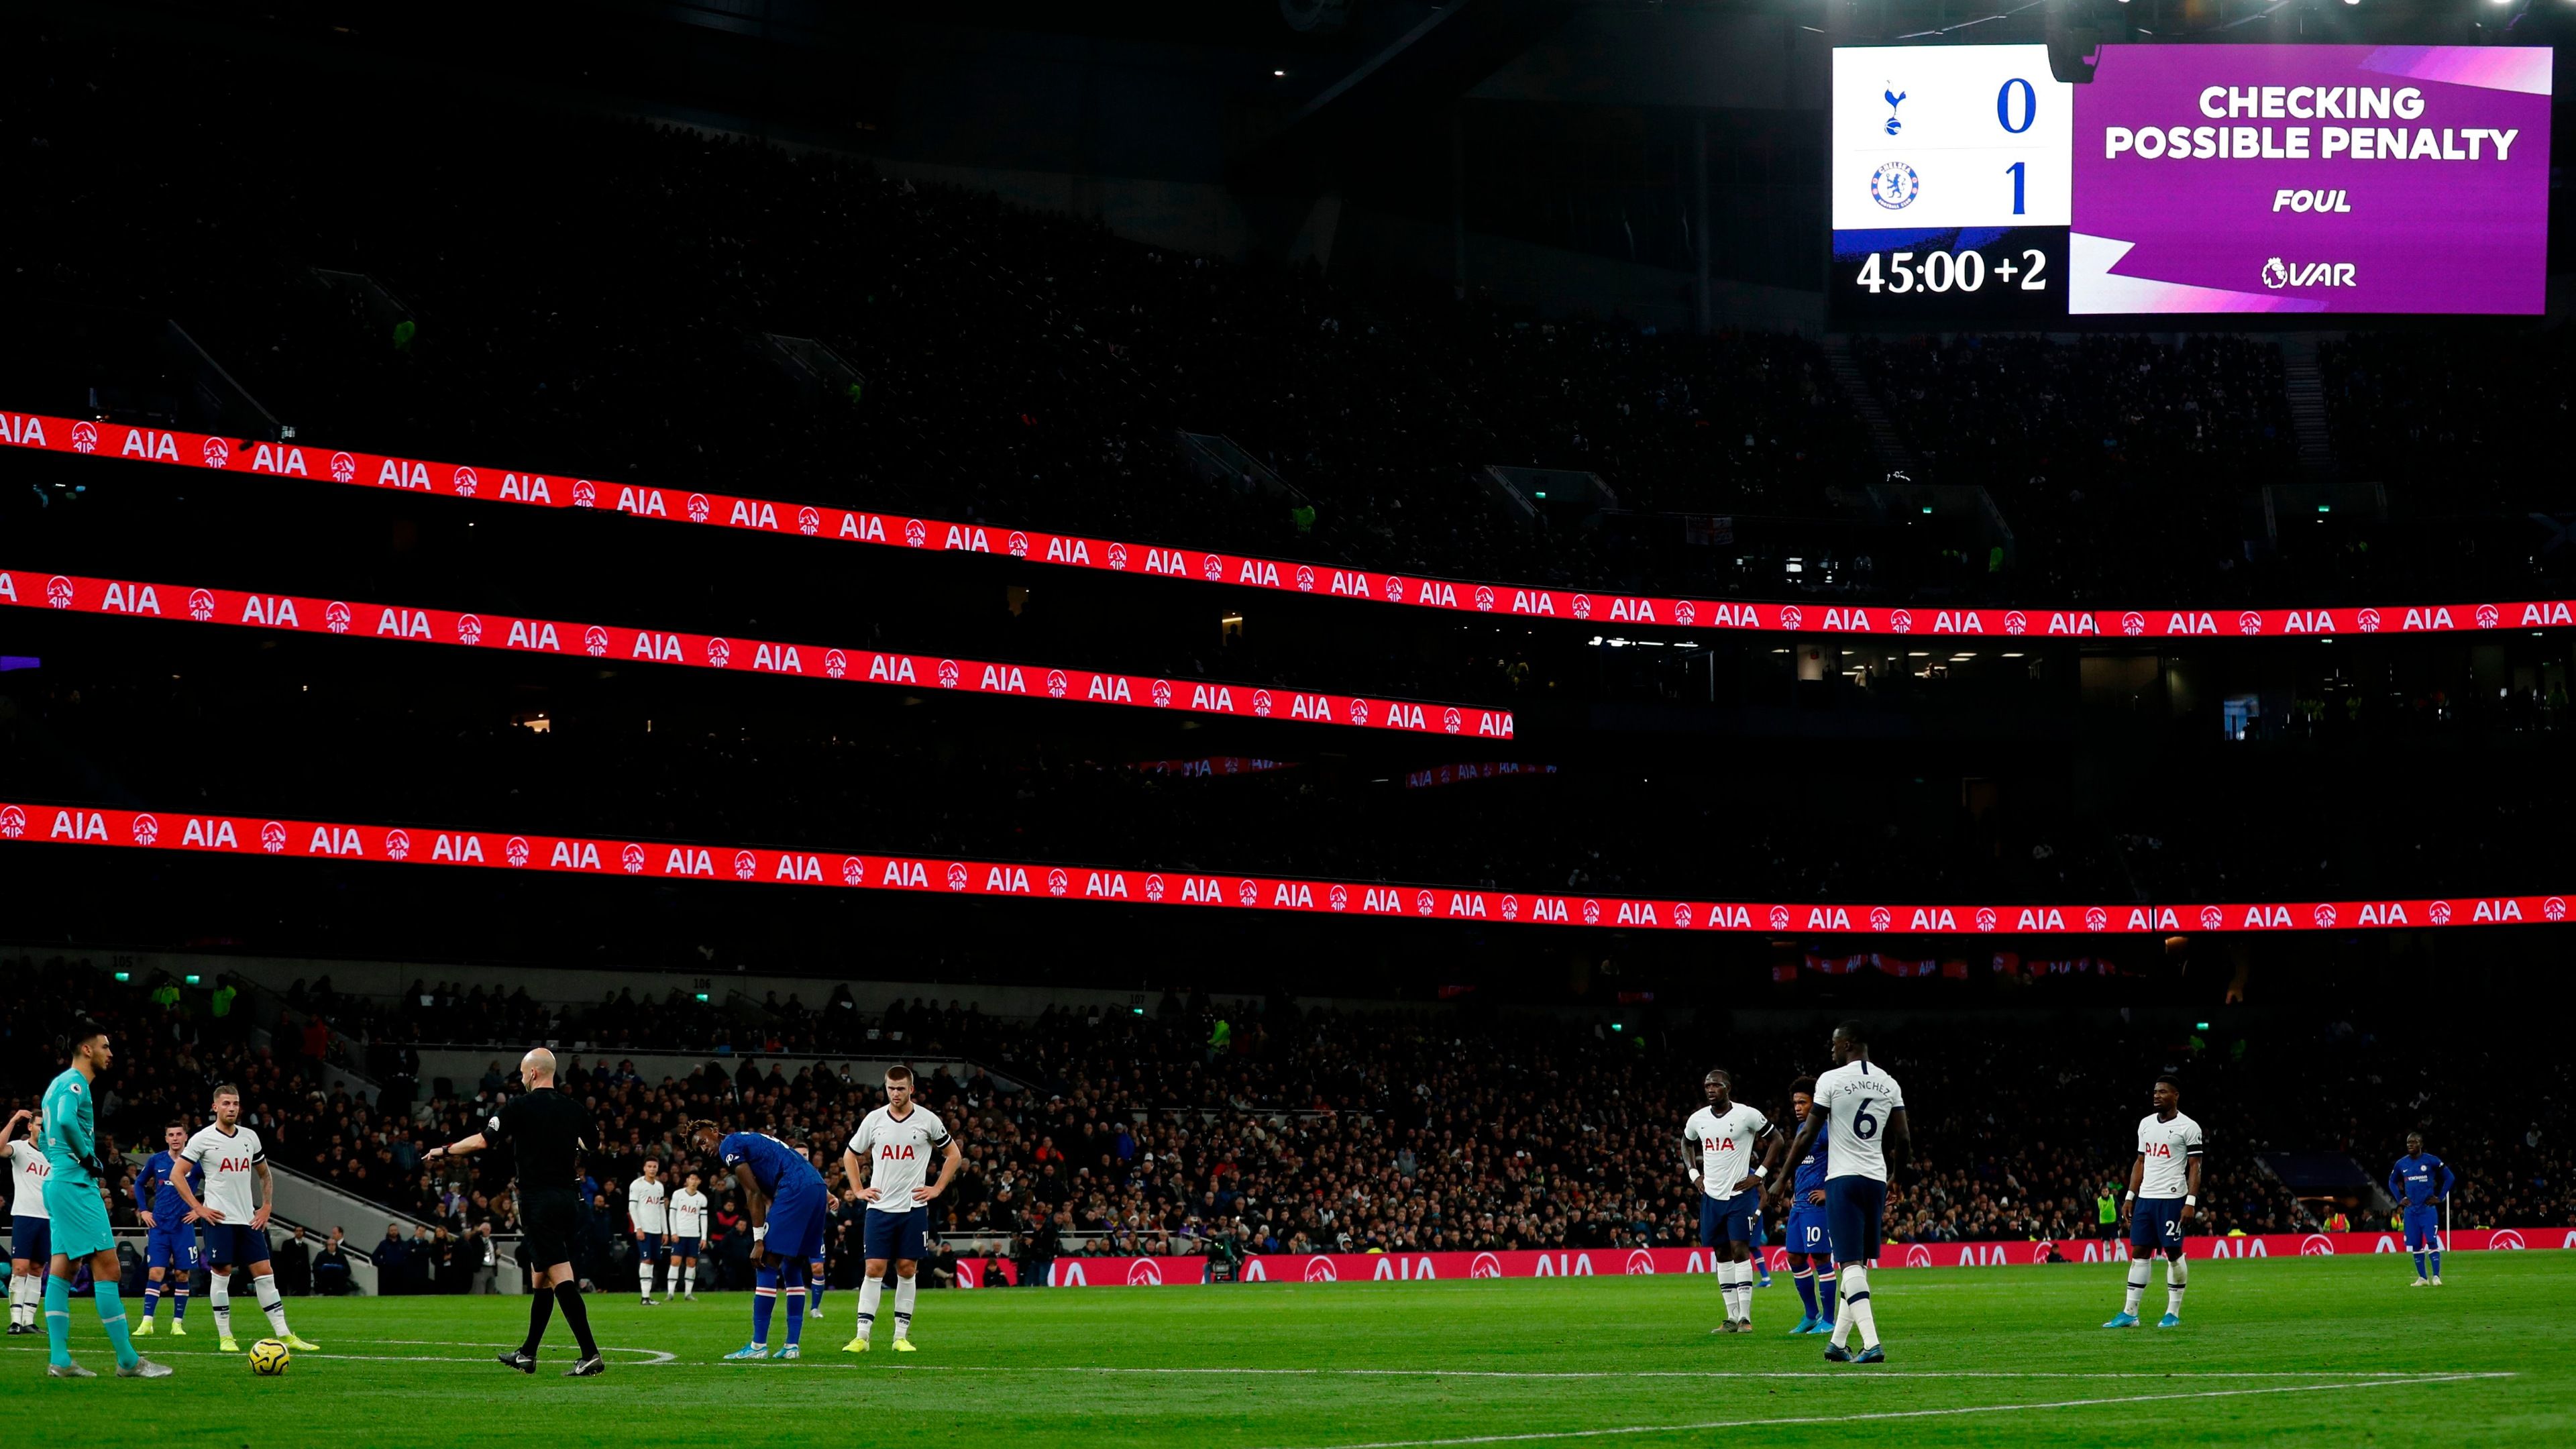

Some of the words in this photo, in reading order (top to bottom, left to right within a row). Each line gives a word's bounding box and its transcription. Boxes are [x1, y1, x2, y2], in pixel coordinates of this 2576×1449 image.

[1996, 78, 2037, 133] 0
[2198, 85, 2426, 119] CHECKING
[2105, 125, 2311, 160] POSSIBLE
[2321, 126, 2519, 161] PENALTY
[2005, 162, 2026, 215] 1
[2271, 189, 2352, 213] FOUL
[1856, 250, 1986, 294] 45:00
[1993, 248, 2047, 291] +2
[2289, 262, 2357, 287] VAR
[122, 429, 179, 461] AIA
[252, 444, 307, 476] AIA
[378, 460, 431, 490] AIA
[499, 474, 551, 504] AIA
[616, 487, 667, 517] AIA
[730, 500, 778, 529] AIA
[839, 513, 886, 541] AIA
[945, 525, 989, 553] AIA
[1046, 537, 1090, 565] AIA
[1144, 549, 1187, 576] AIA
[1239, 560, 1280, 587] AIA
[1331, 571, 1370, 597] AIA
[1419, 582, 1457, 607] AIA
[1512, 590, 1555, 615] AIA
[1609, 598, 1656, 622] AIA
[1715, 604, 1760, 627] AIA
[1823, 608, 1870, 631] AIA
[1933, 611, 1984, 633] AIA
[2048, 612, 2100, 634] AIA
[2167, 612, 2218, 634] AIA
[2284, 610, 2336, 633] AIA
[2403, 607, 2454, 630] AIA
[2521, 602, 2573, 625] AIA
[101, 582, 160, 614] AIA
[241, 595, 299, 627] AIA
[377, 608, 432, 639] AIA
[507, 621, 560, 651] AIA
[633, 632, 684, 661] AIA
[753, 643, 802, 673] AIA
[869, 655, 916, 683] AIA
[981, 665, 1026, 693] AIA
[1088, 675, 1132, 702] AIA
[1191, 685, 1234, 712] AIA
[1291, 694, 1332, 720] AIA
[1387, 704, 1426, 729] AIA
[1479, 712, 1513, 737] AIA
[50, 810, 108, 841] AIA
[182, 818, 237, 848] AIA
[309, 826, 363, 855] AIA
[432, 834, 484, 862] AIA
[551, 841, 601, 869] AIA
[665, 848, 714, 875] AIA
[775, 855, 823, 881] AIA
[883, 861, 928, 888] AIA
[986, 867, 1030, 892] AIA
[1085, 872, 1128, 898] AIA
[1181, 878, 1222, 903] AIA
[1274, 883, 1313, 908] AIA
[1363, 888, 1401, 912] AIA
[1450, 894, 1487, 917] AIA
[1533, 898, 1568, 921] AIA
[1617, 902, 1657, 925] AIA
[1708, 906, 1752, 928] AIA
[1807, 908, 1851, 929] AIA
[1911, 908, 1956, 930] AIA
[2017, 909, 2065, 930] AIA
[2127, 908, 2180, 929] AIA
[2244, 906, 2293, 927] AIA
[2358, 904, 2408, 925] AIA
[2473, 900, 2522, 922] AIA
[1853, 1097, 1878, 1140] 6
[881, 1144, 915, 1160] AIA
[1705, 1137, 1735, 1152] AIA
[2145, 1142, 2171, 1159] AIA
[219, 1157, 250, 1173] AIA
[680, 1205, 698, 1215] AIA
[1807, 1226, 1821, 1242] 10
[2165, 1220, 2182, 1236] 24
[188, 1246, 199, 1260] 19
